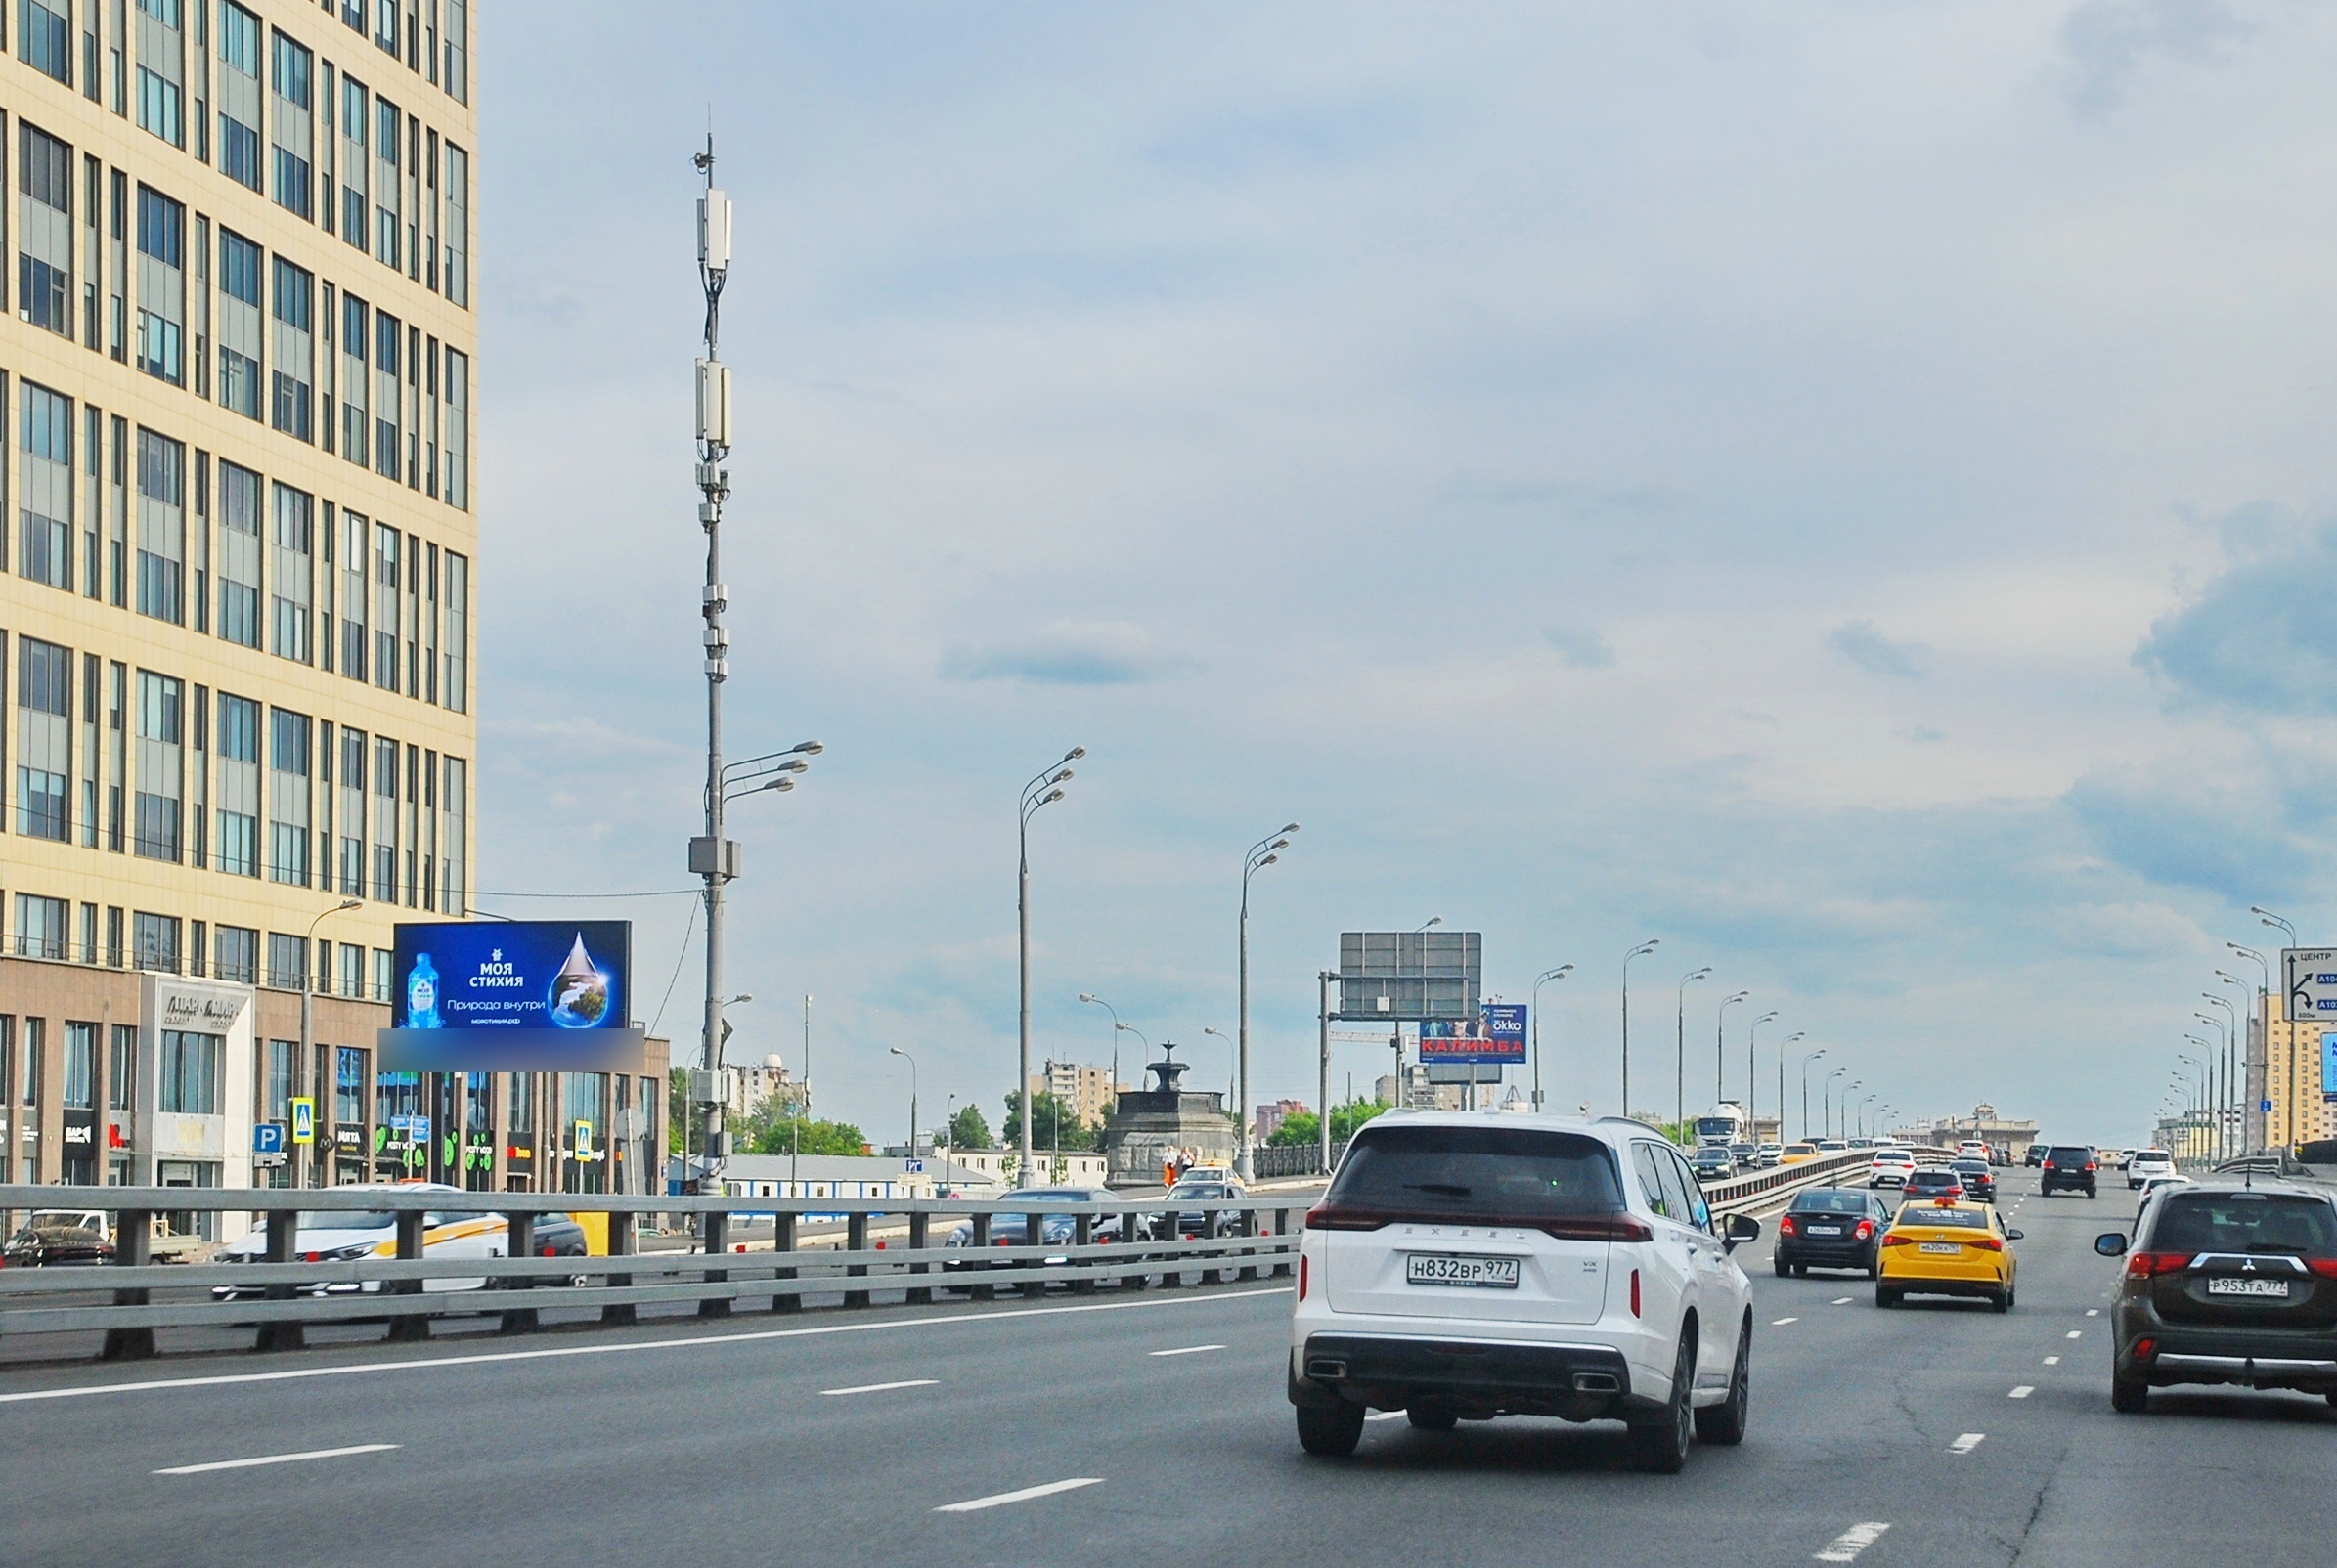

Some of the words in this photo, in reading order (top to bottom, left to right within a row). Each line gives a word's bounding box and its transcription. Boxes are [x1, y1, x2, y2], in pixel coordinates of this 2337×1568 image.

[479, 962, 513, 976] МОЯ
[468, 976, 524, 988] СТИХИЯ
[447, 999, 502, 1012] Природа
[503, 1000, 546, 1012] внутри
[1422, 1040, 1523, 1053] КАЛИМБА
[1413, 1259, 1482, 1280] Н832ВР
[1485, 1261, 1513, 1275] 977
[2213, 1280, 2264, 1293] Р953ТА
[2265, 1281, 2284, 1290] 777
